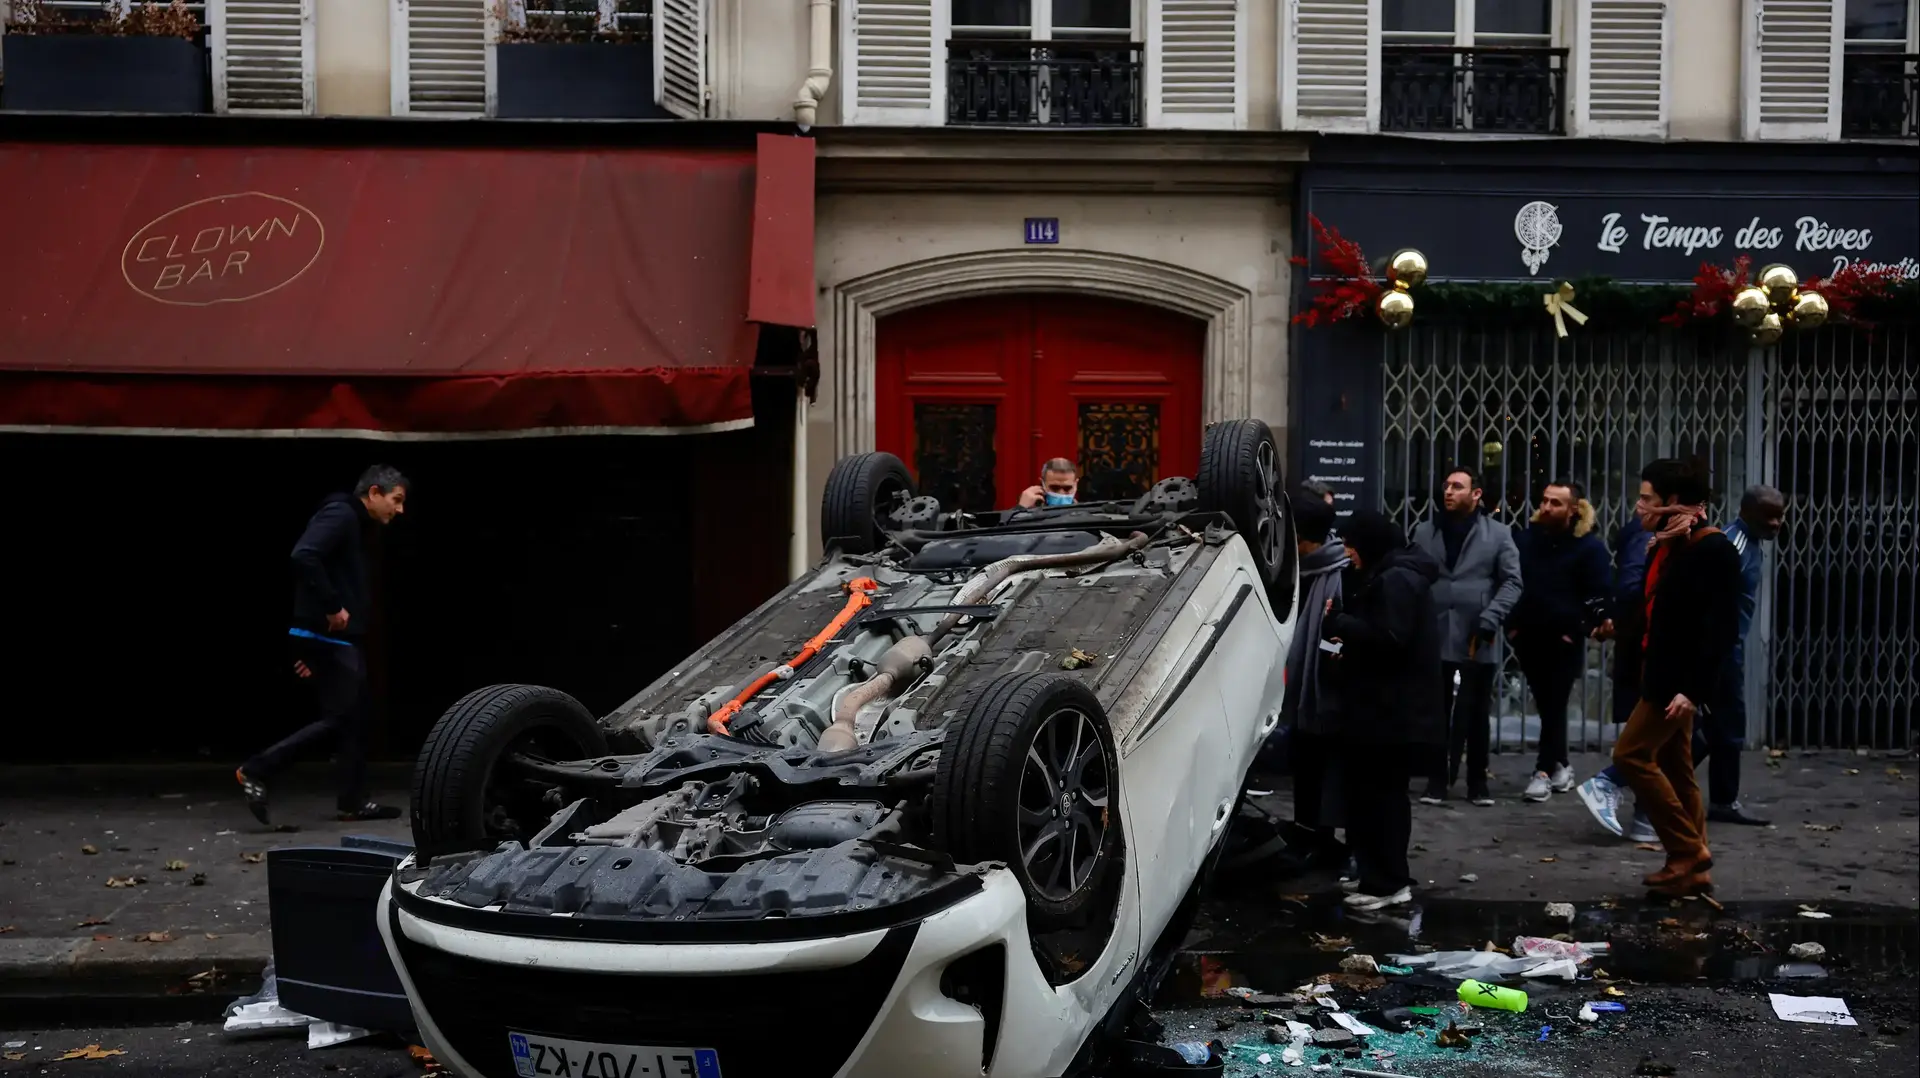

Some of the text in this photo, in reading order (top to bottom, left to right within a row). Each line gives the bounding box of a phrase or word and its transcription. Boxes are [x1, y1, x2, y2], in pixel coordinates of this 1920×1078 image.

[137, 213, 300, 262] CLOWN
[1030, 221, 1054, 240] 114
[1598, 212, 1873, 256] Le Temps des Rêves
[154, 250, 250, 290] BAR
